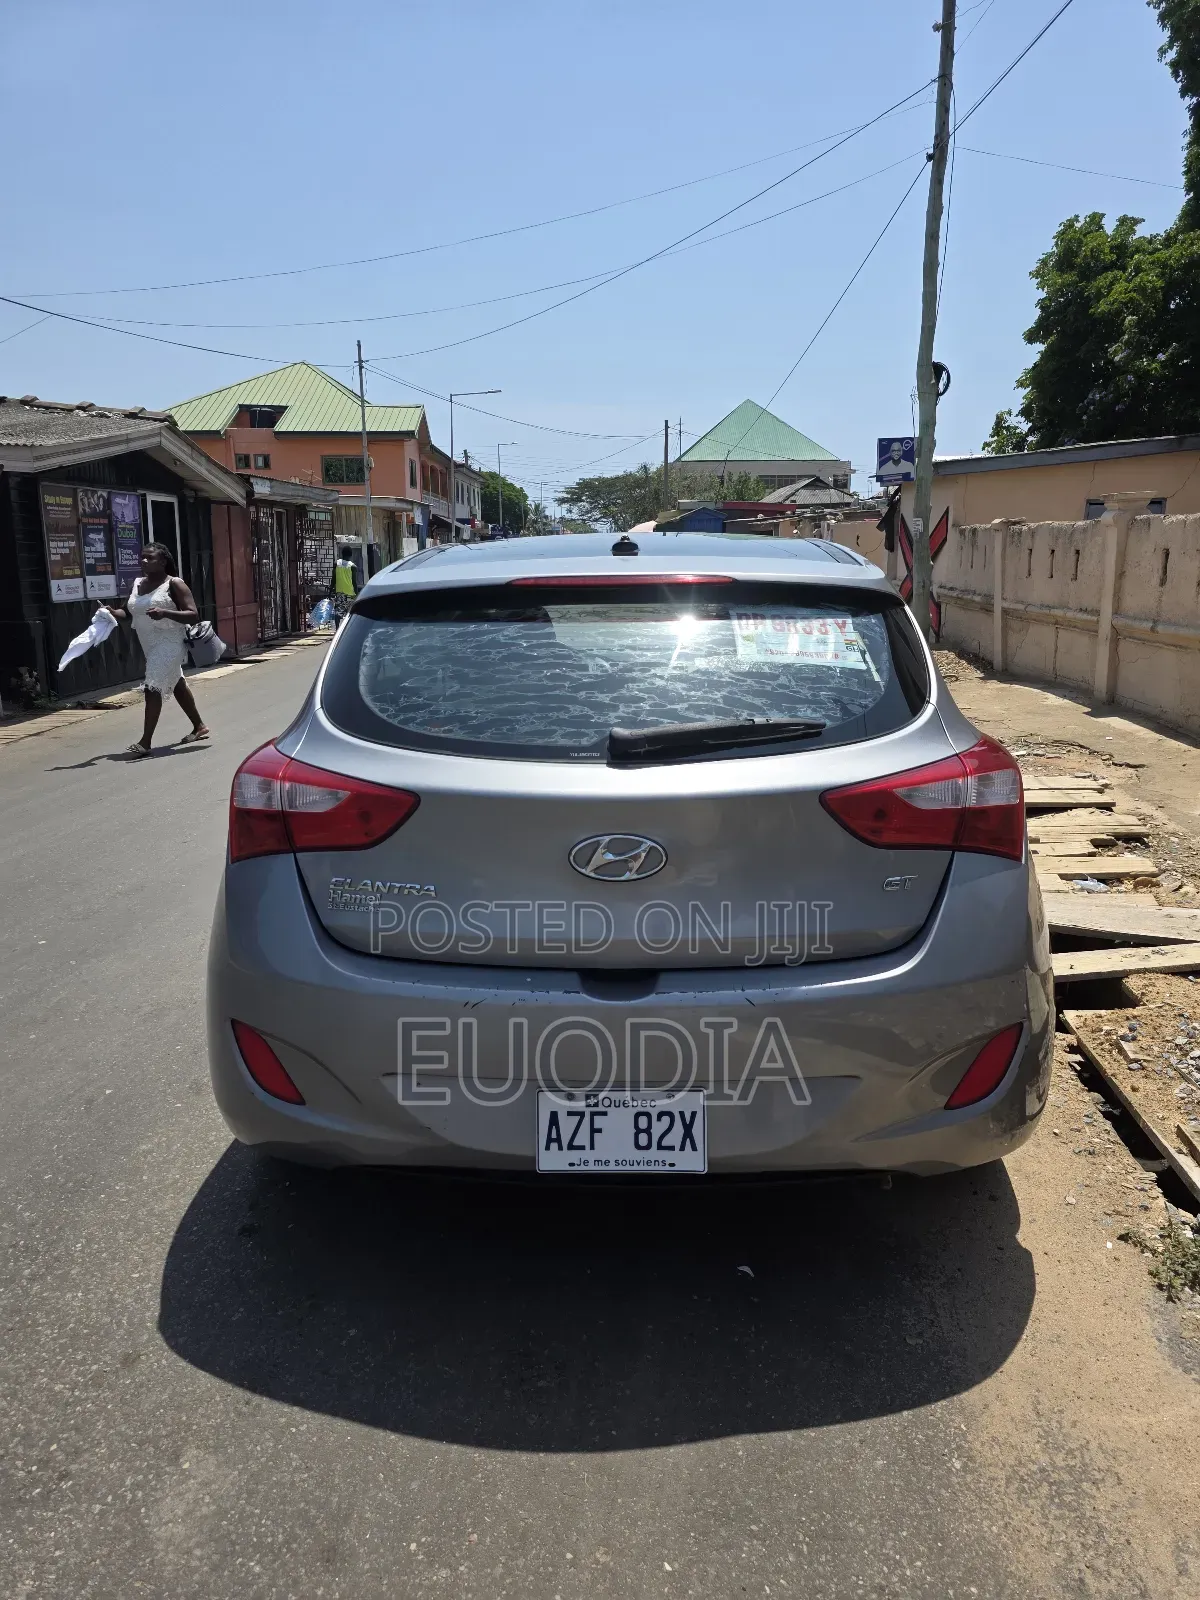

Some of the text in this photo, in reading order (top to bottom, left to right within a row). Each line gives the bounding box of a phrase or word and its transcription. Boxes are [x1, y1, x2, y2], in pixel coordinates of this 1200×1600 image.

[329, 877, 437, 898] ELANTRA
[601, 1096, 657, 1108] Québec
[544, 1110, 698, 1152] AZF 82X
[576, 1157, 667, 1167] Je me souviens
